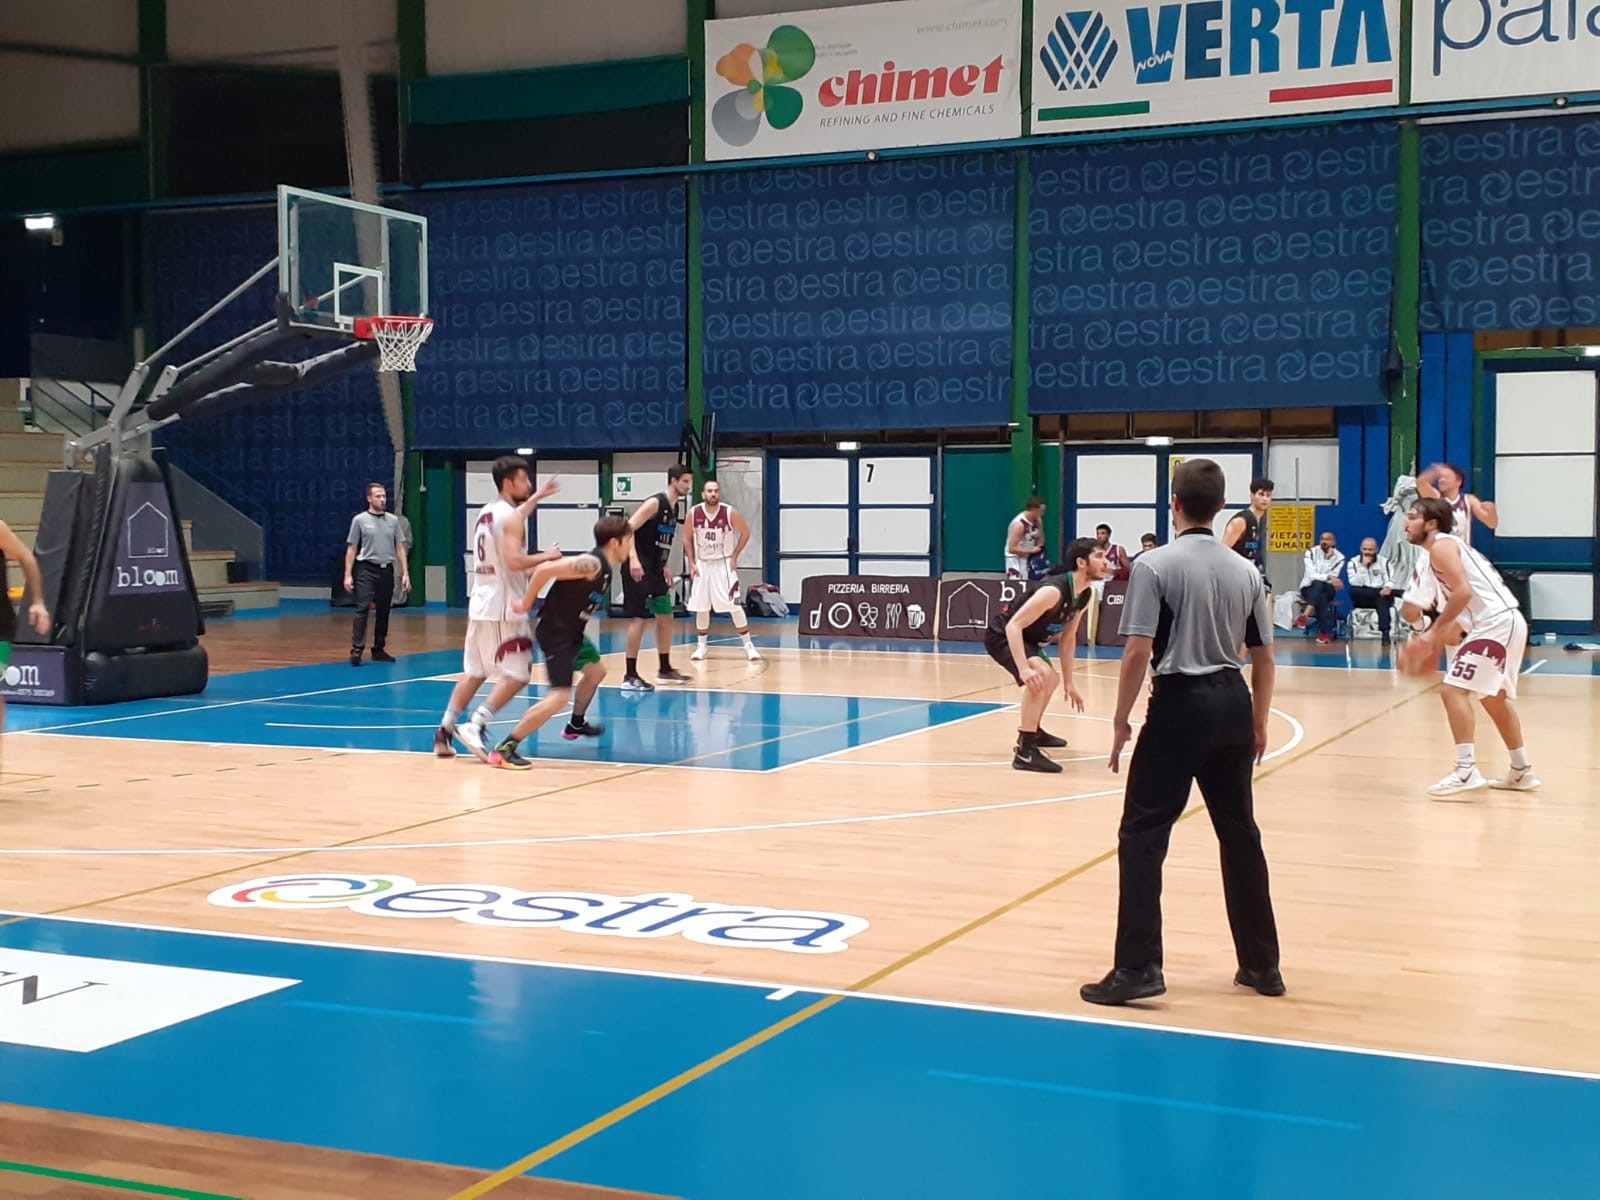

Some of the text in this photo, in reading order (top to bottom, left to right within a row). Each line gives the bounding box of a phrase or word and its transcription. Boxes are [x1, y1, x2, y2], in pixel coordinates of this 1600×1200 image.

[1135, 50, 1174, 73] NOVA
[818, 54, 1005, 107] chimet
[820, 104, 995, 128] REFINING AND FINE CHEMICALS
[1316, 141, 1393, 177] estr
[1515, 160, 1600, 198] estr
[945, 181, 1014, 216] estr
[626, 219, 686, 250] estr
[941, 370, 1011, 402] estr
[628, 394, 684, 425] estr
[865, 463, 875, 483] 7
[705, 531, 717, 542] 40
[116, 566, 179, 587] bloom
[828, 583, 910, 595] PIZZERIA BIRRERIA
[1452, 661, 1477, 681] 55
[373, 883, 846, 949] estra
